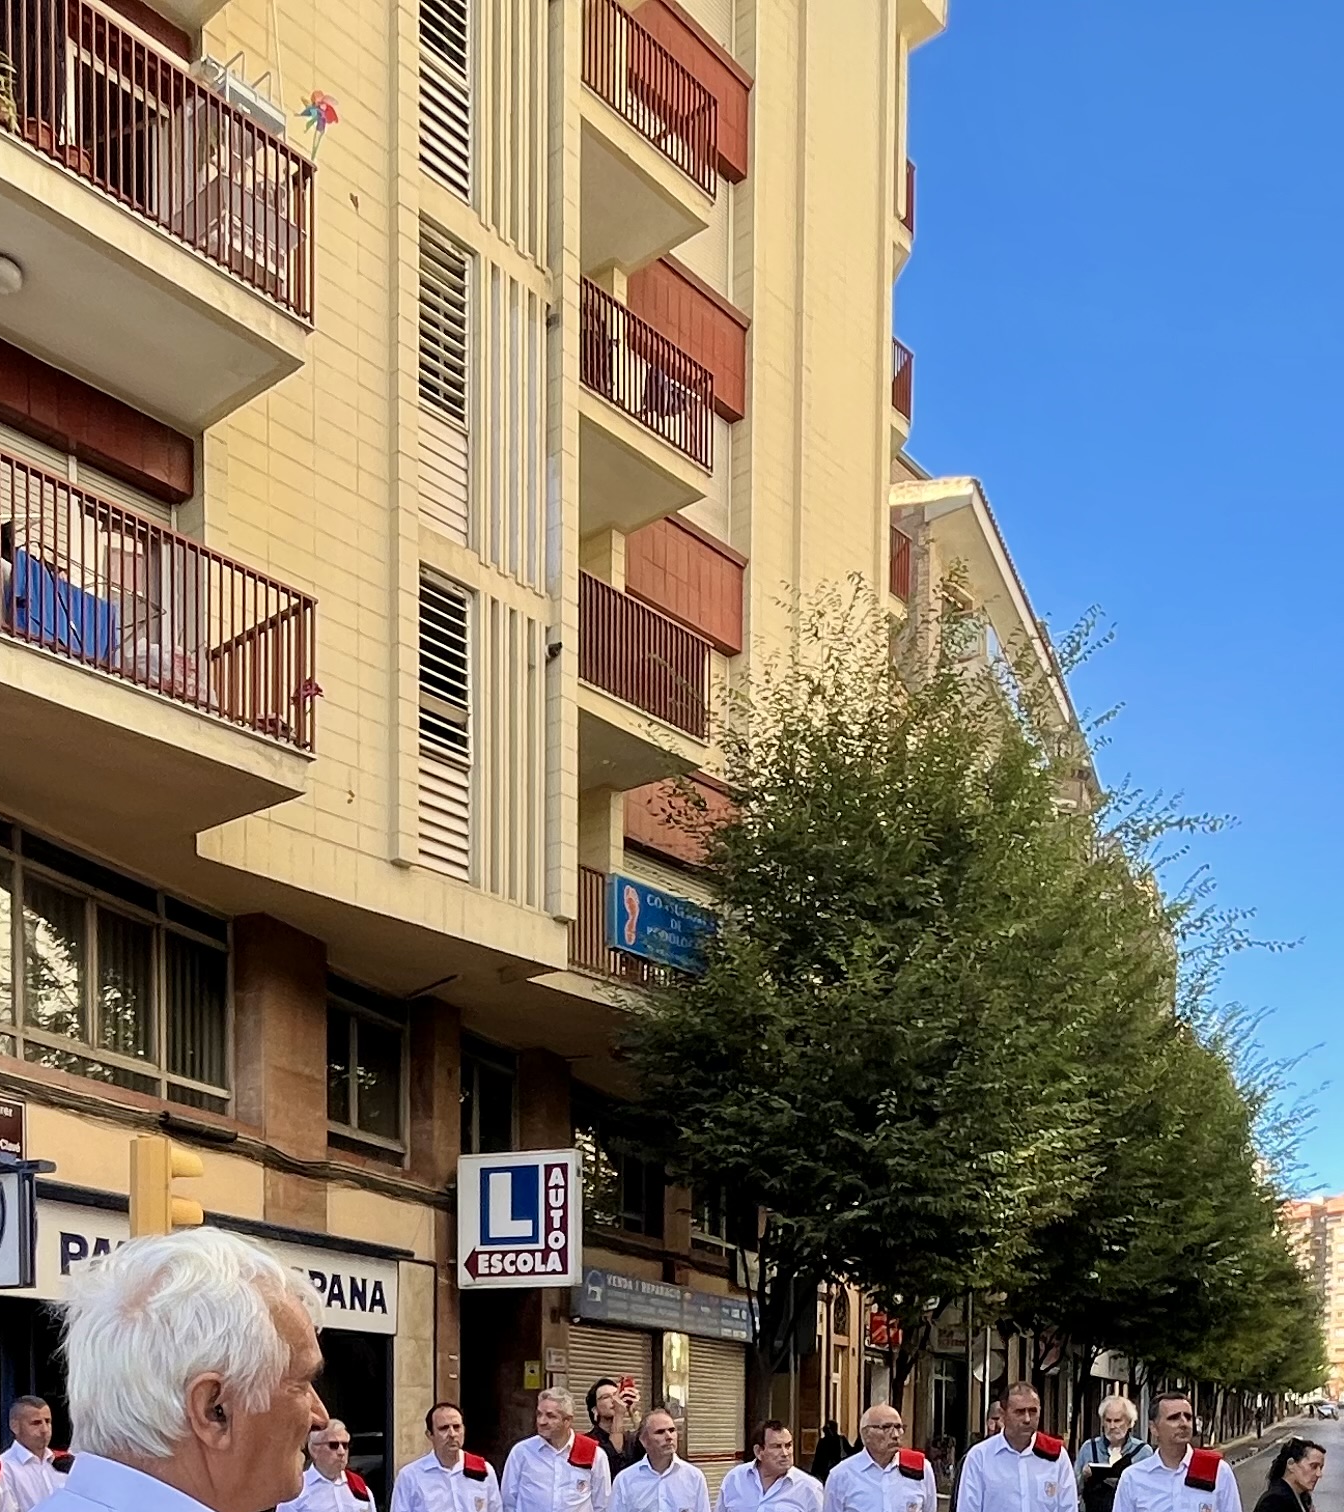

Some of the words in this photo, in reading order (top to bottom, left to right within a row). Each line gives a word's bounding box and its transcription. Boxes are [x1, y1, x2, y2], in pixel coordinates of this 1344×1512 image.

[489, 1172, 533, 1238] L
[547, 1167, 565, 1250] AUTO
[477, 1252, 563, 1274] ESCOLA
[298, 1268, 388, 1315] PANA
